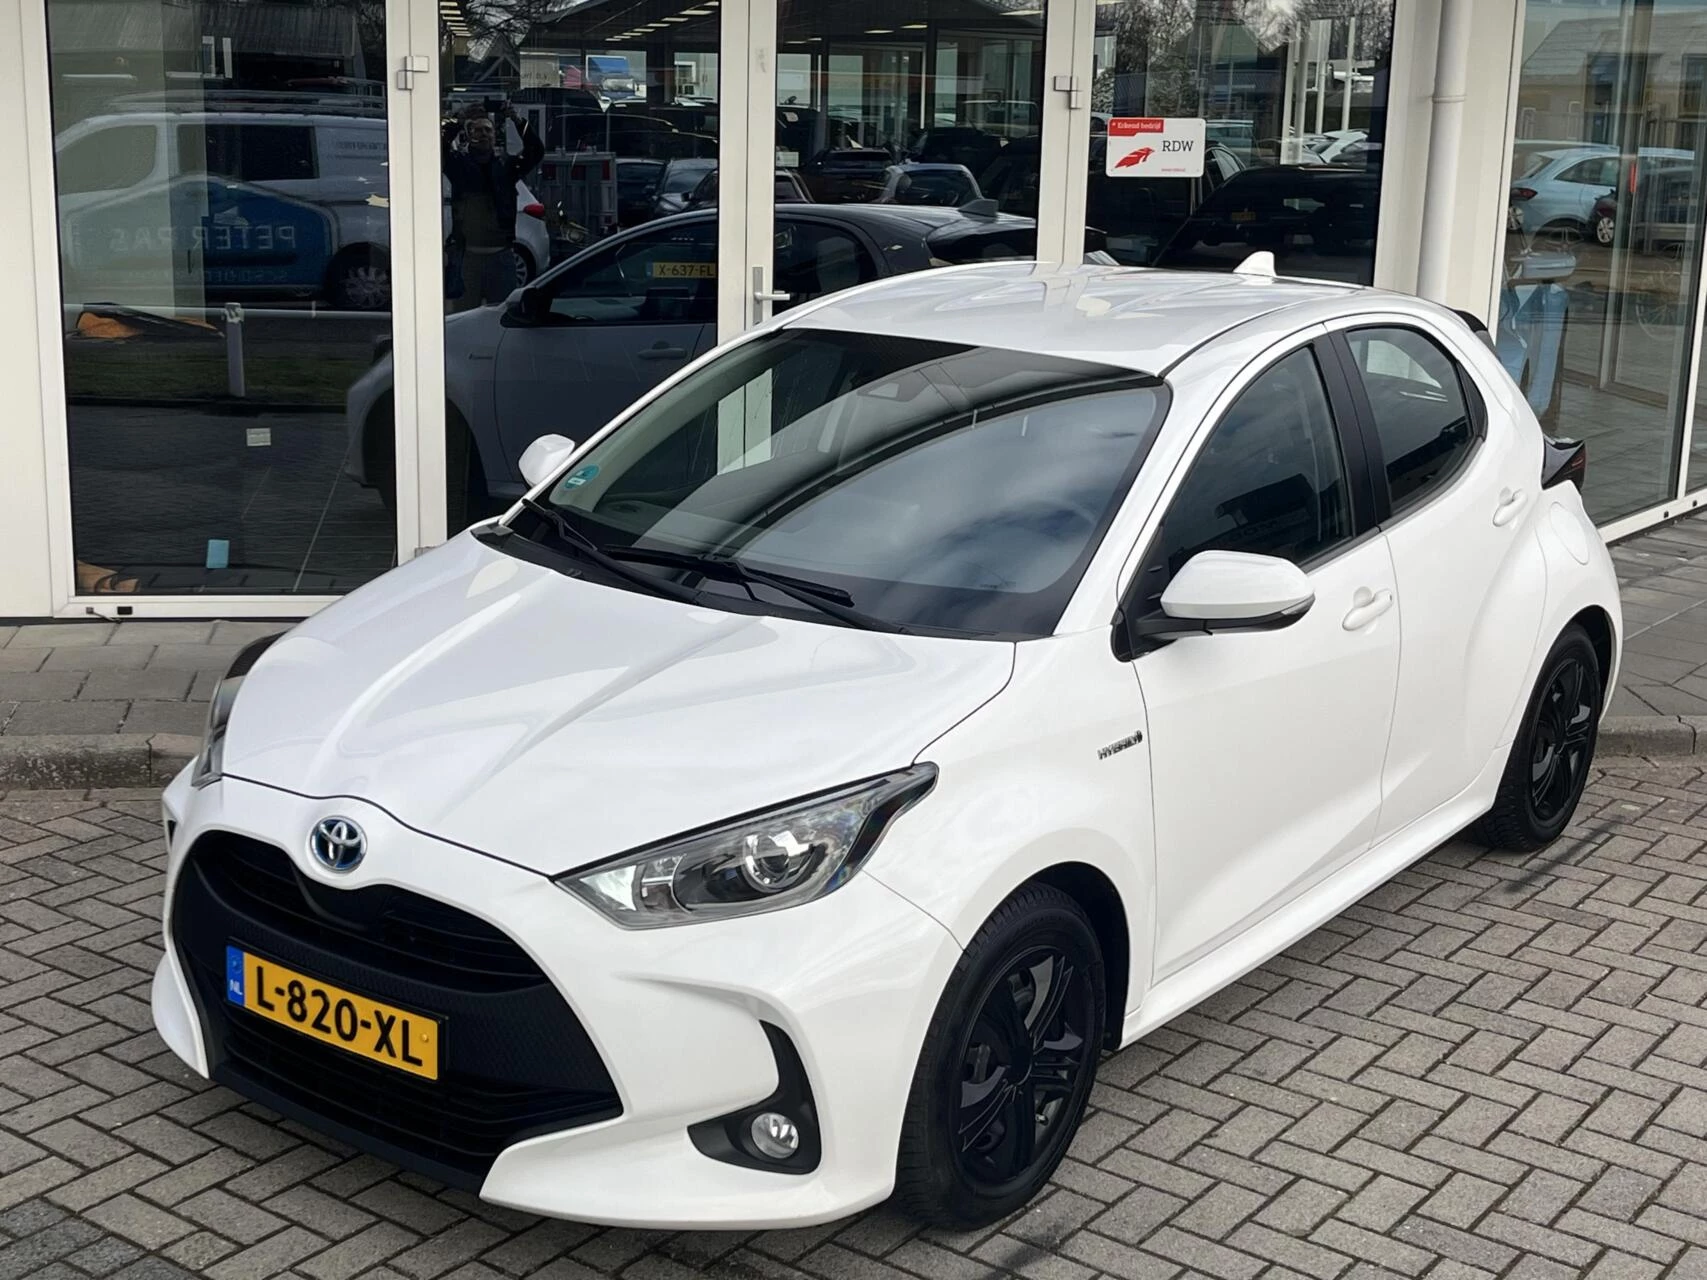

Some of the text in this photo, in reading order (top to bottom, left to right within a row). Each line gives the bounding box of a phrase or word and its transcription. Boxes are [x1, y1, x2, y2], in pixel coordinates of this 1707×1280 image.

[1162, 140, 1194, 152] RDW
[659, 264, 713, 276] X-637-FL
[229, 979, 243, 996] NL
[256, 966, 423, 1067] L-820-XL
